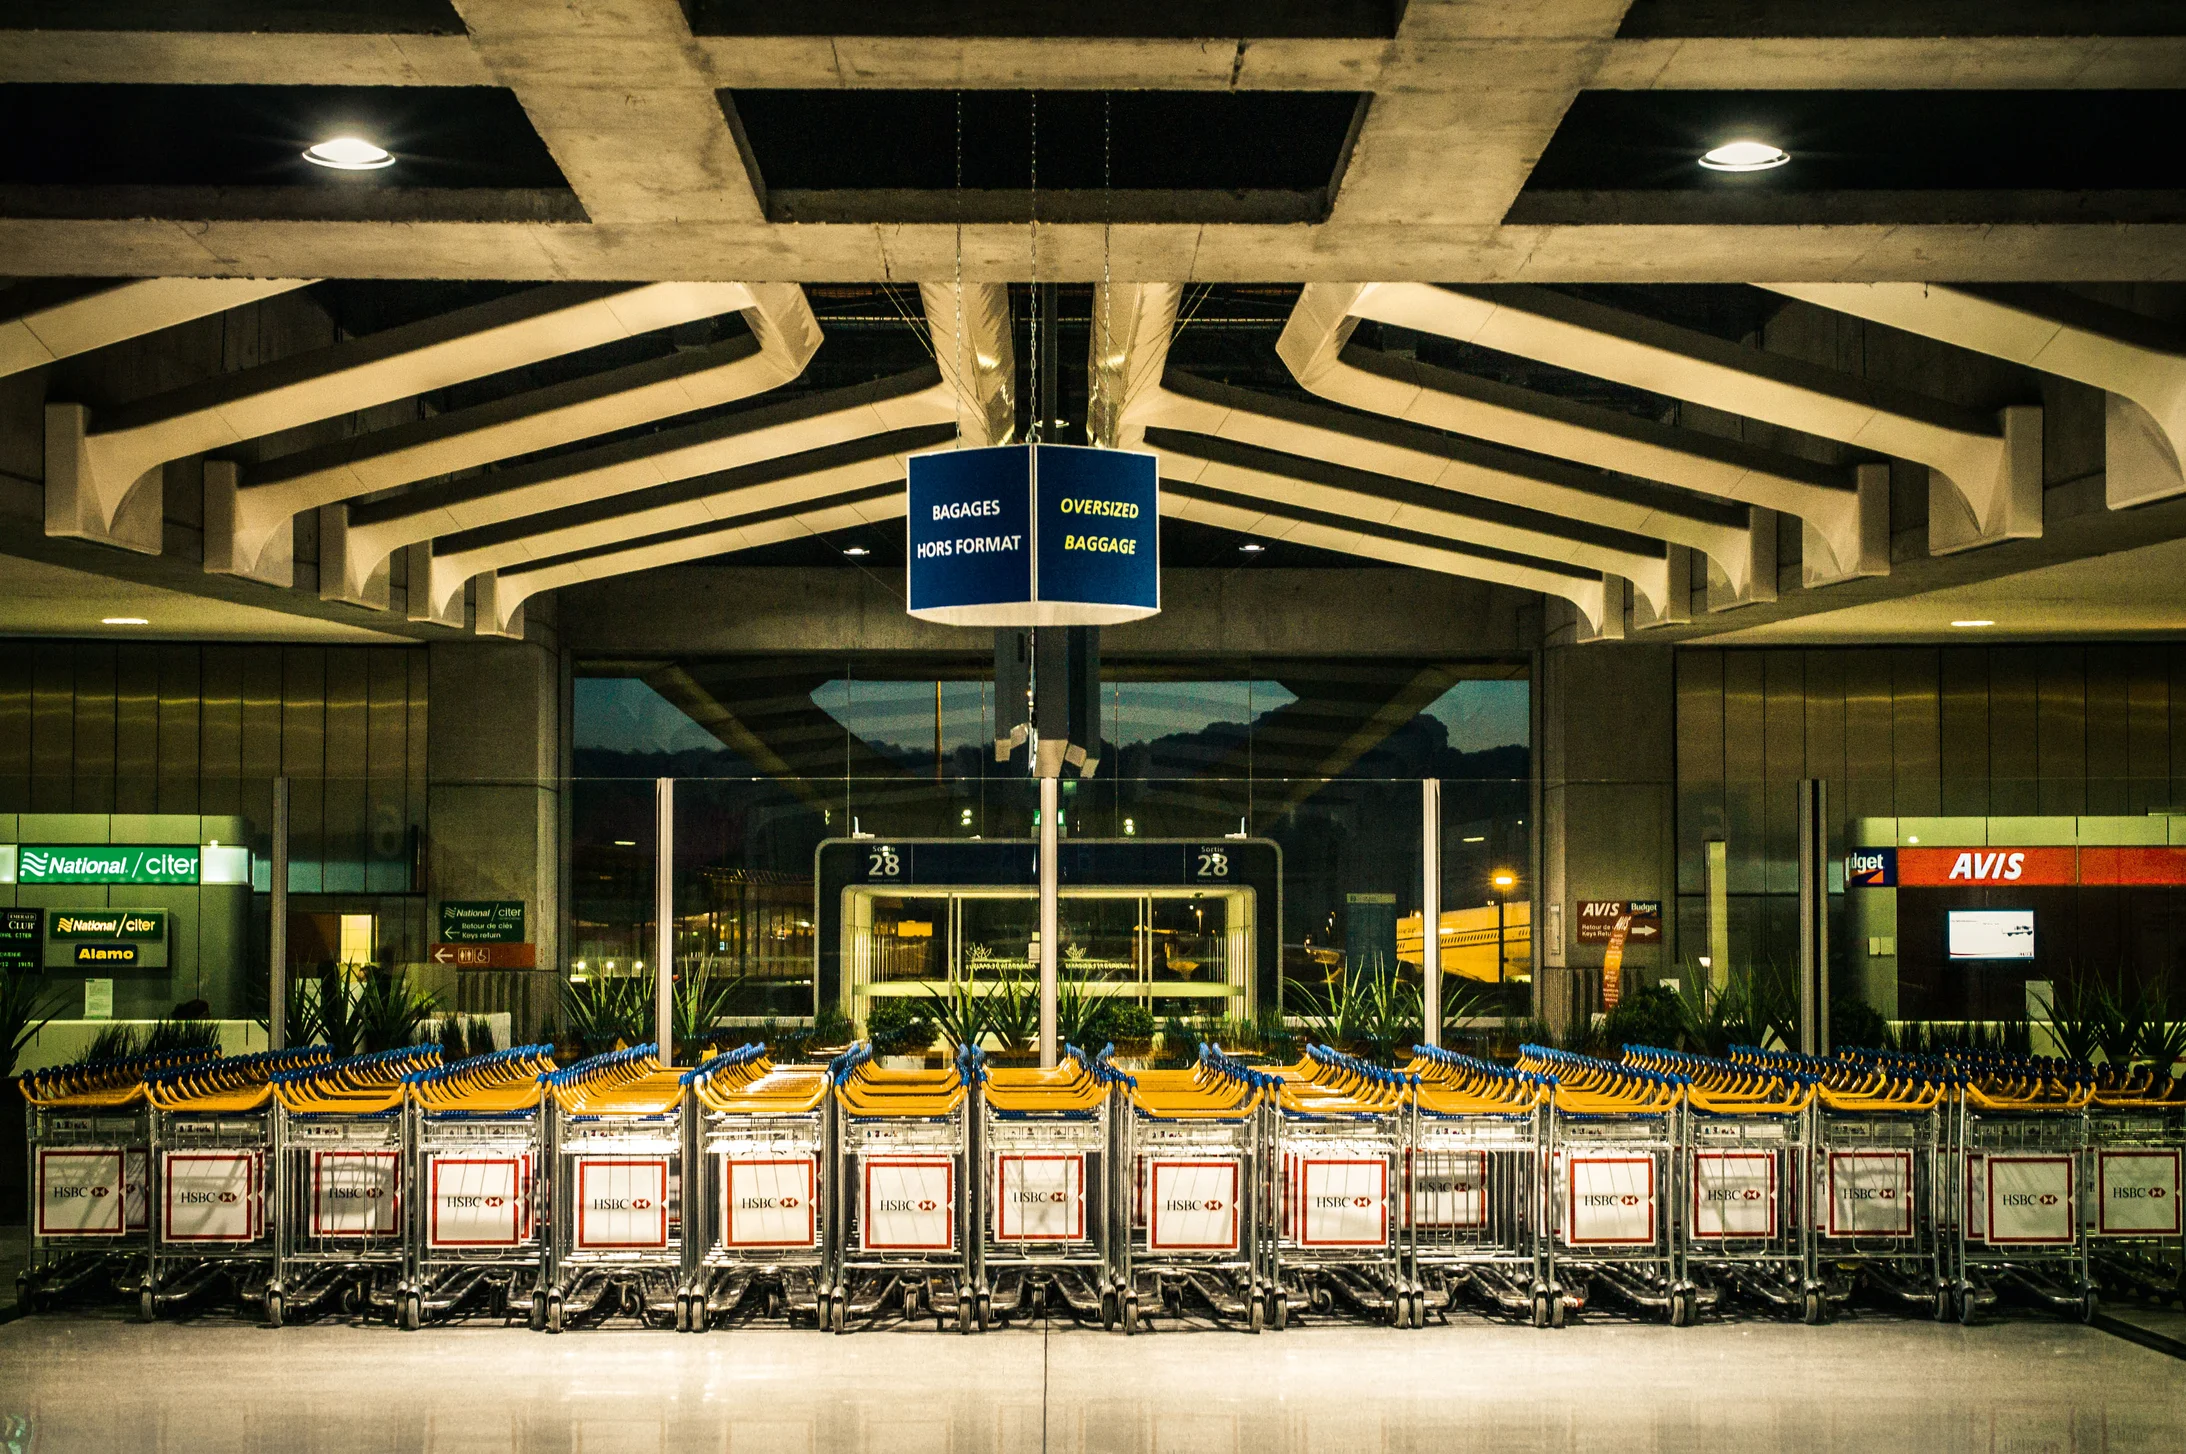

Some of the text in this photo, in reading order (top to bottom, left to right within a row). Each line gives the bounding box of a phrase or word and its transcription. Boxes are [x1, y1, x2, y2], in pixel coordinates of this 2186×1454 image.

[932, 500, 1001, 520] BAGAGES
[1060, 498, 1139, 519] OVERSIZED
[917, 535, 1021, 559] HORS FORMAT
[1064, 535, 1136, 555] BAGGAGE
[49, 854, 198, 875] National citer
[868, 854, 900, 876] 28
[1197, 854, 1229, 877] 28
[1948, 852, 2025, 880] AVIS
[456, 907, 521, 917] National citer
[1582, 903, 1620, 917] AVIS
[1631, 903, 1657, 912] Budget
[72, 918, 155, 931] National citer
[79, 948, 134, 960] Alamo
[54, 1187, 88, 1198] HSBC
[181, 1192, 215, 1203] HSBC
[329, 1187, 363, 1199] HSBC
[1013, 1192, 1048, 1203] HSBC
[1708, 1189, 1741, 1201] HSBC
[1843, 1188, 1877, 1200] HSBC
[2113, 1187, 2147, 1199] HSBC
[447, 1196, 481, 1208] HSBC
[594, 1198, 629, 1210] HSBC
[742, 1197, 777, 1209] HSBC
[880, 1200, 915, 1211] HSBC
[1167, 1200, 1202, 1211] HSBC
[1317, 1197, 1351, 1208] HSBC
[1584, 1195, 1618, 1206] HSBC
[2003, 1194, 2037, 1206] HSBC
